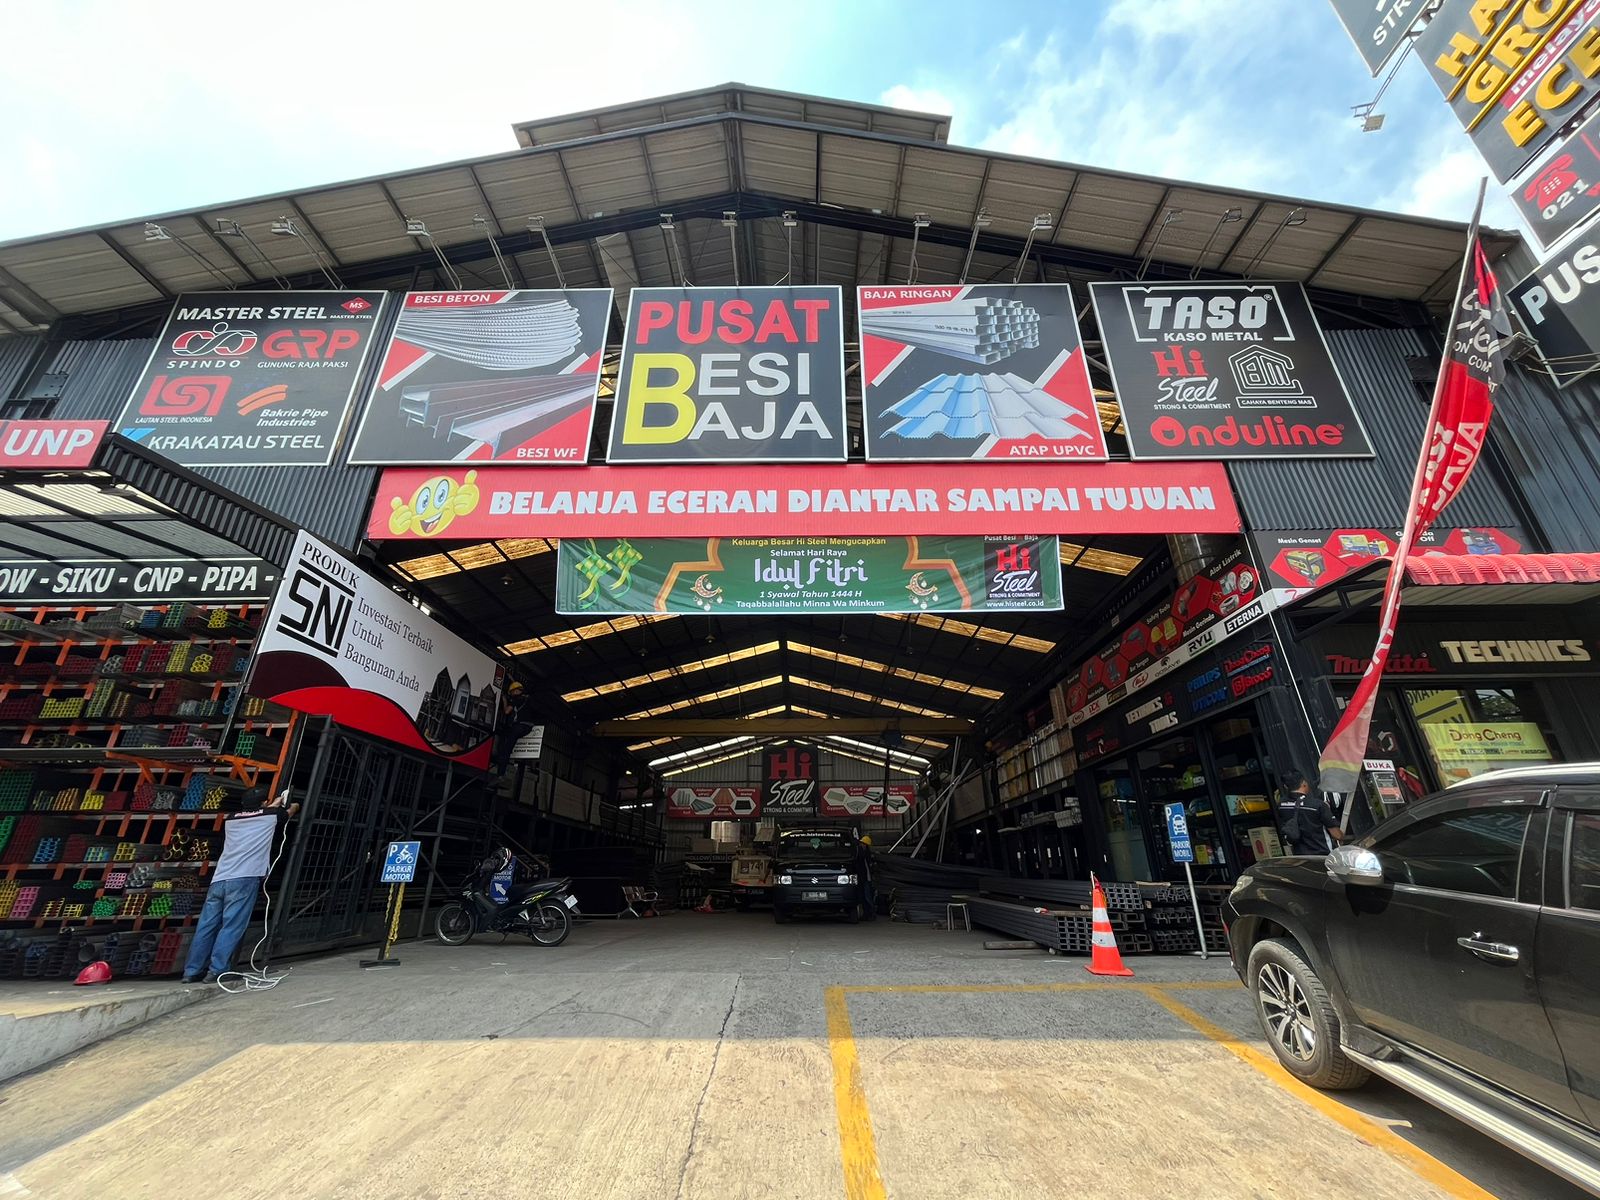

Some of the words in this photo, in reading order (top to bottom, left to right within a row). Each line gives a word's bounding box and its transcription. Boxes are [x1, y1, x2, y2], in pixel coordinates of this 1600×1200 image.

[1542, 179, 1590, 220] 021
[414, 295, 443, 304] BESI
[445, 293, 491, 303] BETON
[864, 290, 897, 299] BAJA
[900, 289, 952, 299] RINGAN
[176, 306, 263, 320] MASTER
[267, 306, 328, 320] STEEL
[635, 299, 830, 345] PUSAT
[262, 328, 361, 359] GRP
[1163, 332, 1207, 342] KASO
[1211, 331, 1263, 341] METAL
[166, 359, 241, 369] SPINDO
[257, 361, 296, 369] GUNUNG
[321, 360, 349, 368] PAKSI
[1150, 345, 1209, 378] Hi
[1157, 377, 1220, 403] Steel
[256, 417, 316, 427] Industries
[259, 408, 300, 418] Bakrie
[301, 408, 328, 418] Pipe
[148, 435, 261, 450] KRAKATAU
[263, 434, 325, 449] STEEL
[1150, 415, 1344, 447] Onduline
[4, 429, 96, 456] UNP
[516, 448, 549, 458] BESI
[552, 447, 578, 458] WF
[1009, 445, 1048, 456] ATAP
[1053, 445, 1096, 455] UPVC
[488, 490, 638, 515] BELANJA
[647, 490, 777, 514] ECERAN
[787, 488, 940, 514] DIANTAR
[947, 488, 1080, 512] SAMPAI
[1085, 486, 1216, 511] TUJUAN
[732, 538, 769, 547] Keluarga
[829, 537, 886, 547] Mengucapkan
[807, 549, 825, 557] Hari
[827, 549, 847, 558] Raya
[995, 544, 1032, 571] Hi
[1222, 548, 1242, 567] Listrik
[302, 541, 361, 589] PRODUK
[52, 568, 115, 594] SIKU
[133, 567, 183, 593] CNP
[201, 566, 257, 592] PIPA
[990, 570, 1038, 592] Steel
[736, 600, 801, 609] Taqabbalallahu
[767, 590, 800, 599] Syawal
[801, 590, 829, 598] Tahun
[830, 590, 853, 598] 1444
[357, 597, 402, 635] Investasi
[402, 624, 435, 654] Terbaik
[1226, 605, 1262, 632] ETERNA
[352, 620, 385, 650] Untuk
[1188, 631, 1212, 653] RYU
[1440, 639, 1592, 664] TECHNICS
[344, 643, 395, 682] Bangunan
[397, 670, 420, 692] Anda
[768, 747, 812, 779] Hi
[767, 779, 815, 806] Steel
[1165, 807, 1172, 821] P
[389, 844, 398, 857] P
